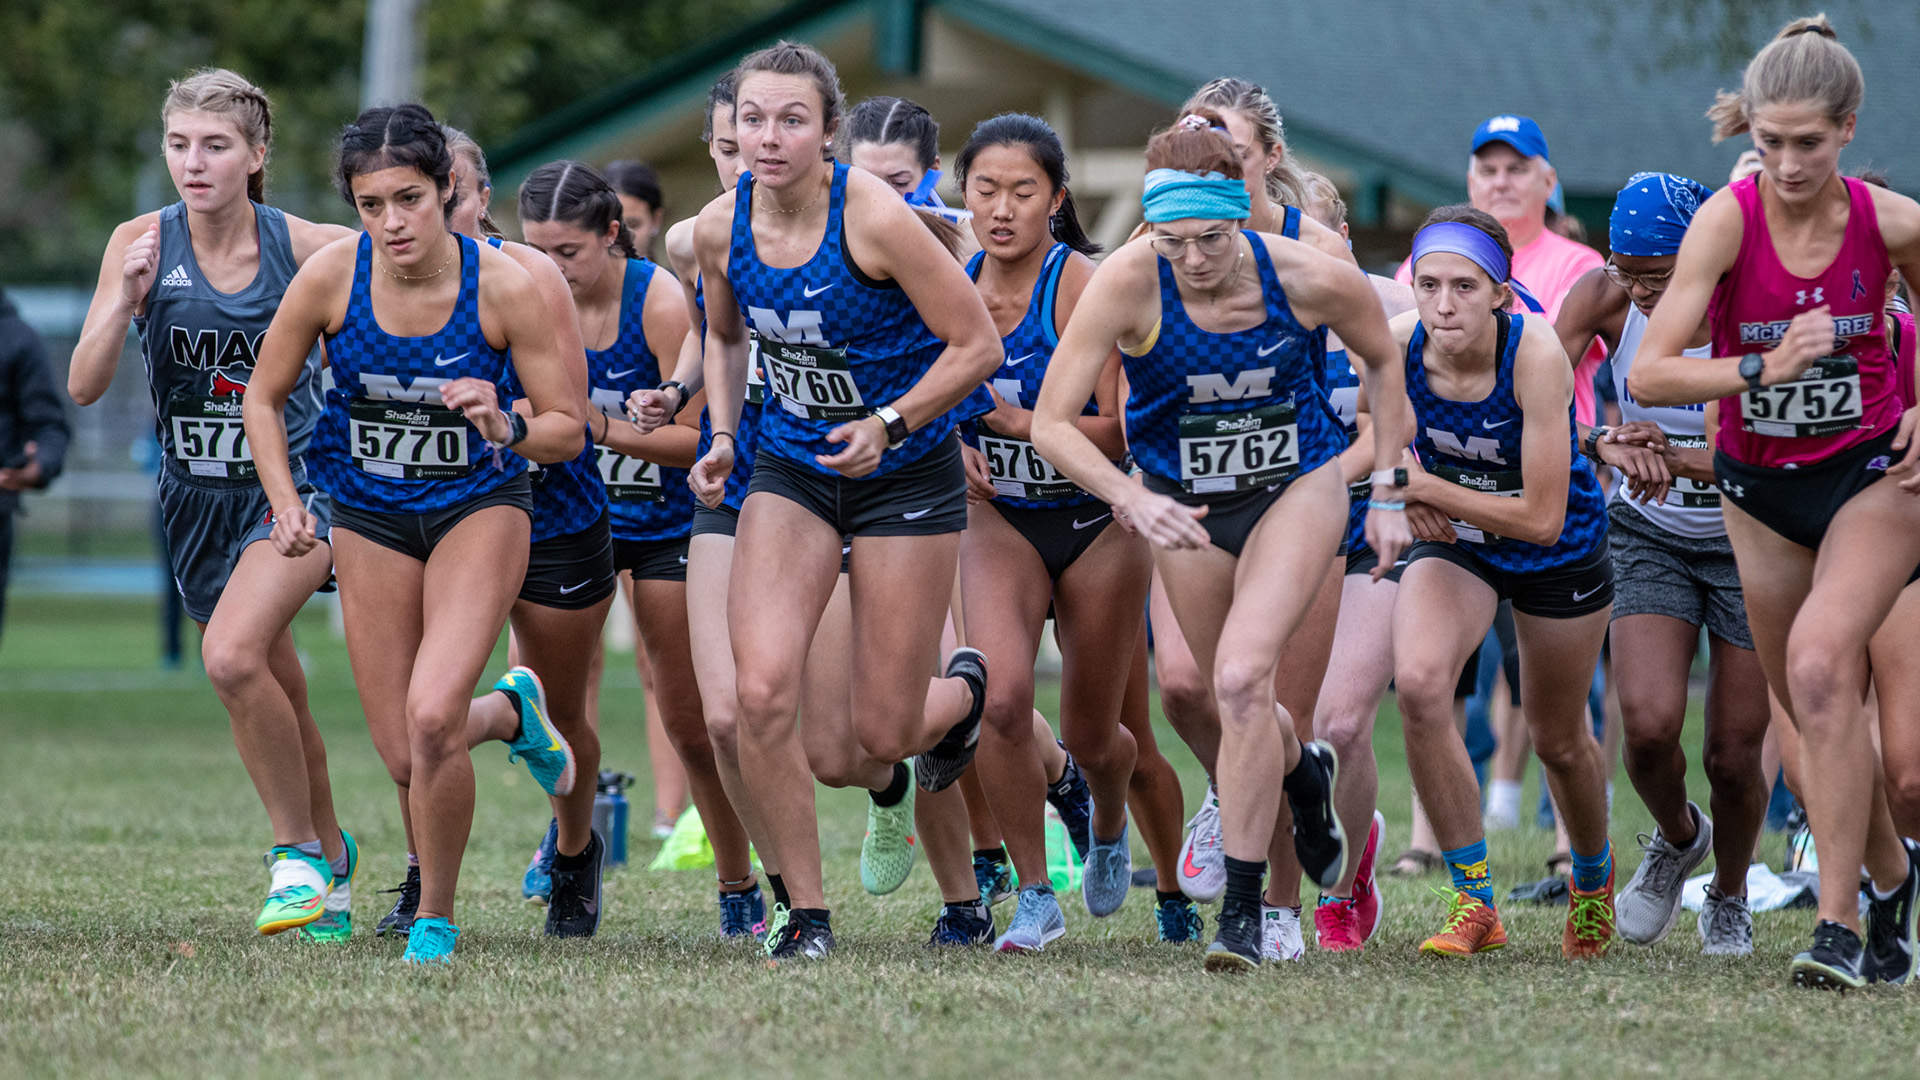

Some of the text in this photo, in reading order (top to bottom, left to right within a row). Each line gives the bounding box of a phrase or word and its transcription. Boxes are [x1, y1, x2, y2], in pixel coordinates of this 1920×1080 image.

[161, 277, 193, 287] adidas
[748, 305, 831, 348] M
[1740, 314, 1873, 344] McKREE
[170, 325, 268, 371] MA
[781, 347, 817, 362] ShaZam
[798, 360, 818, 368] racing
[359, 372, 454, 406] M
[769, 358, 854, 404] 5760
[1187, 366, 1276, 404] M
[384, 409, 431, 421] ShaZam
[1749, 381, 1855, 420] 5752
[407, 419, 430, 427] racing
[1216, 418, 1262, 431] ShaZam
[1240, 424, 1262, 433] racing
[358, 423, 460, 463] 5770
[1189, 429, 1292, 476] 5762
[1426, 427, 1507, 465] M
[1668, 437, 1708, 450] ShaZam
[1459, 474, 1497, 486] ShaZam
